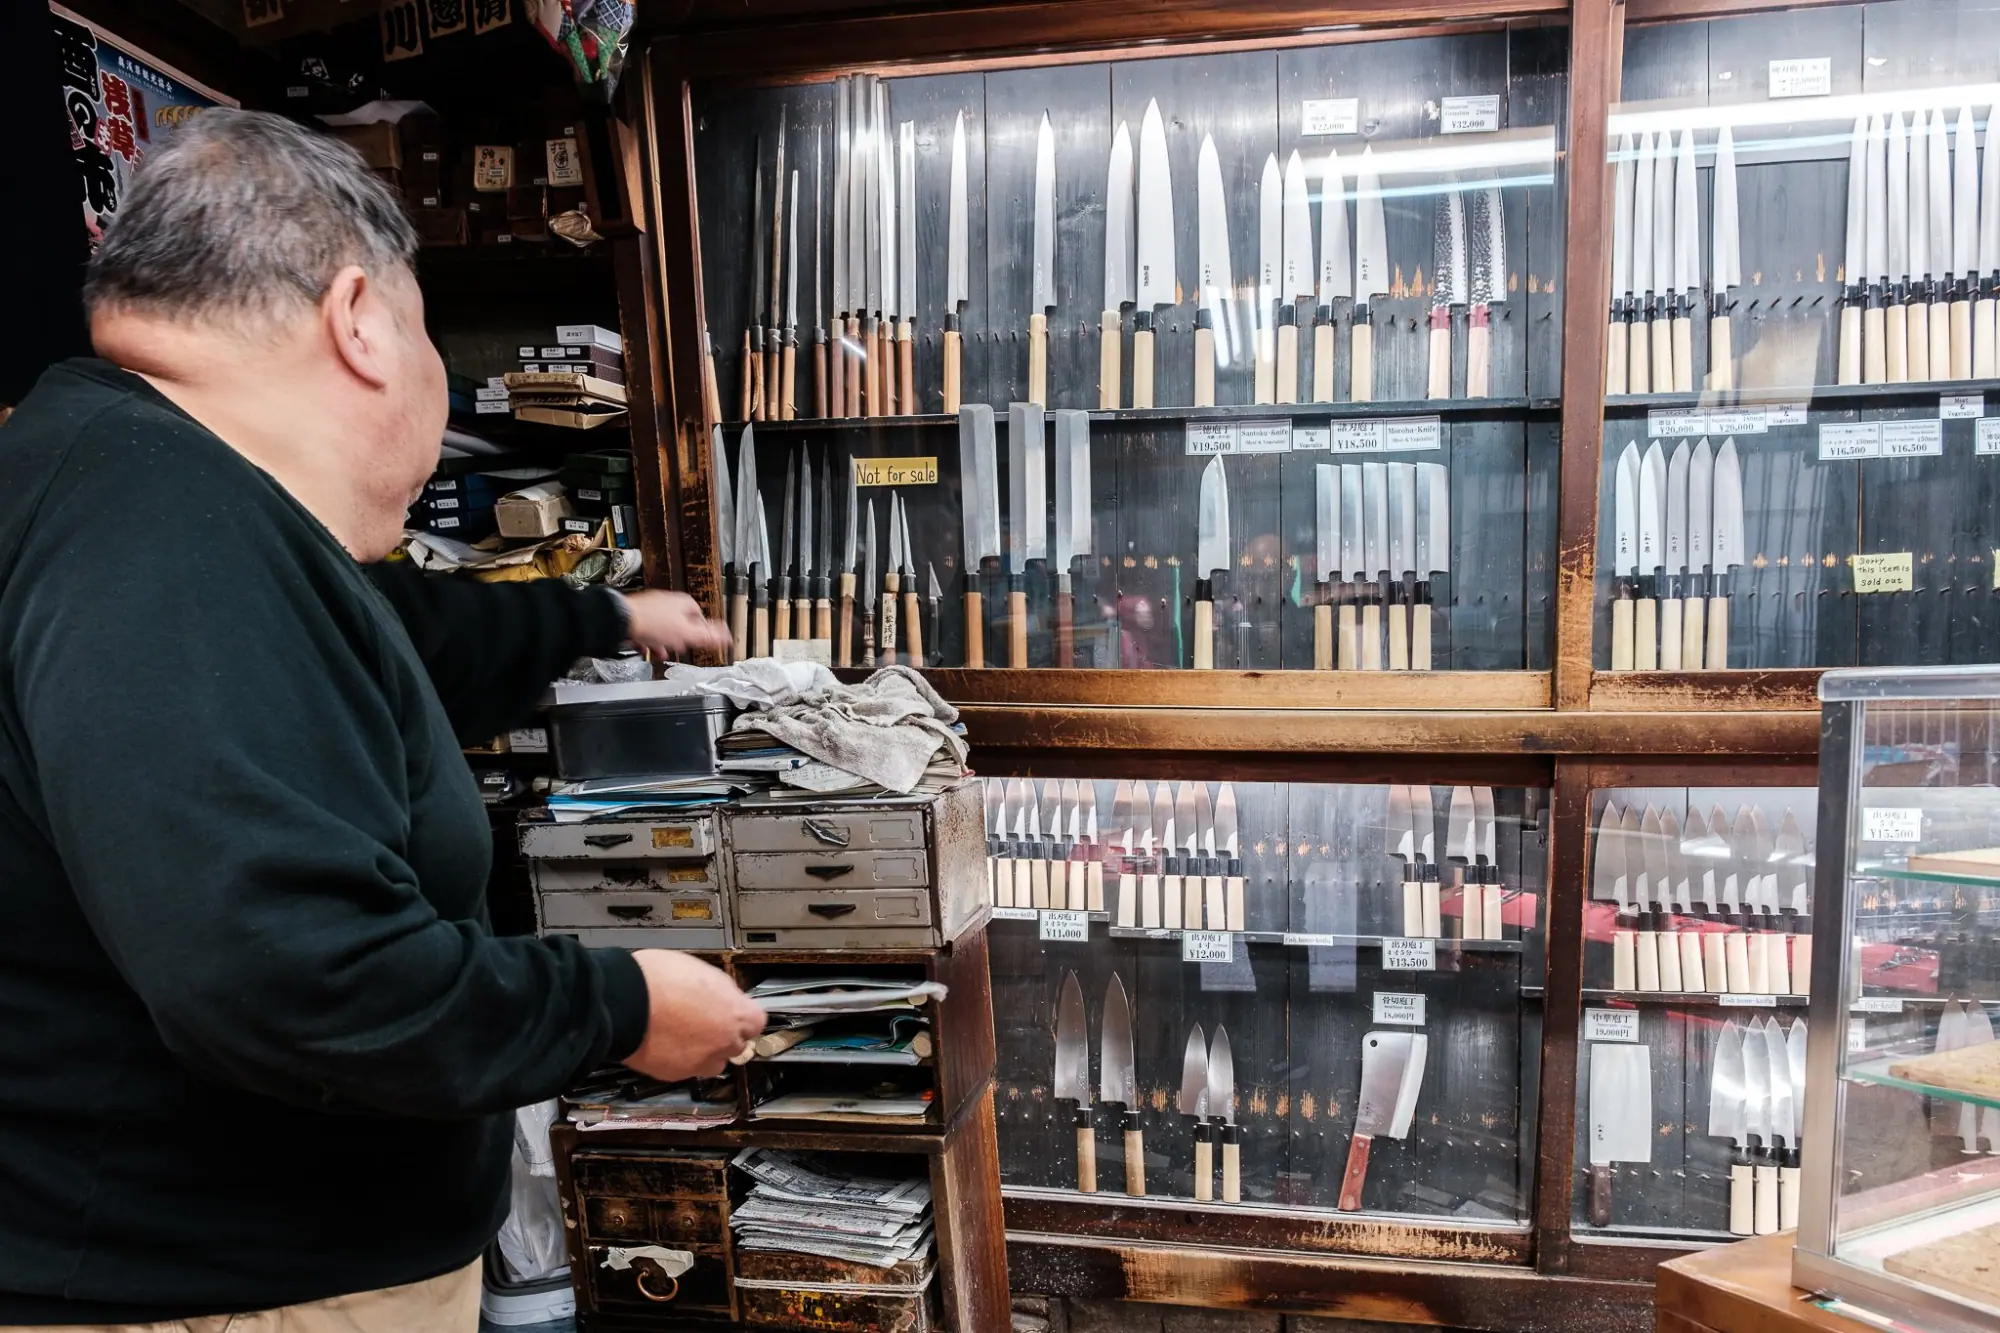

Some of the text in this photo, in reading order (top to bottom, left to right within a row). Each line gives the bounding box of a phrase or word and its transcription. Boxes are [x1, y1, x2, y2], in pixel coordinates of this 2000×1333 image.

[856, 461, 936, 485] Not for sale
[1858, 565, 1910, 574] this item is
[1884, 576, 1904, 585] out
